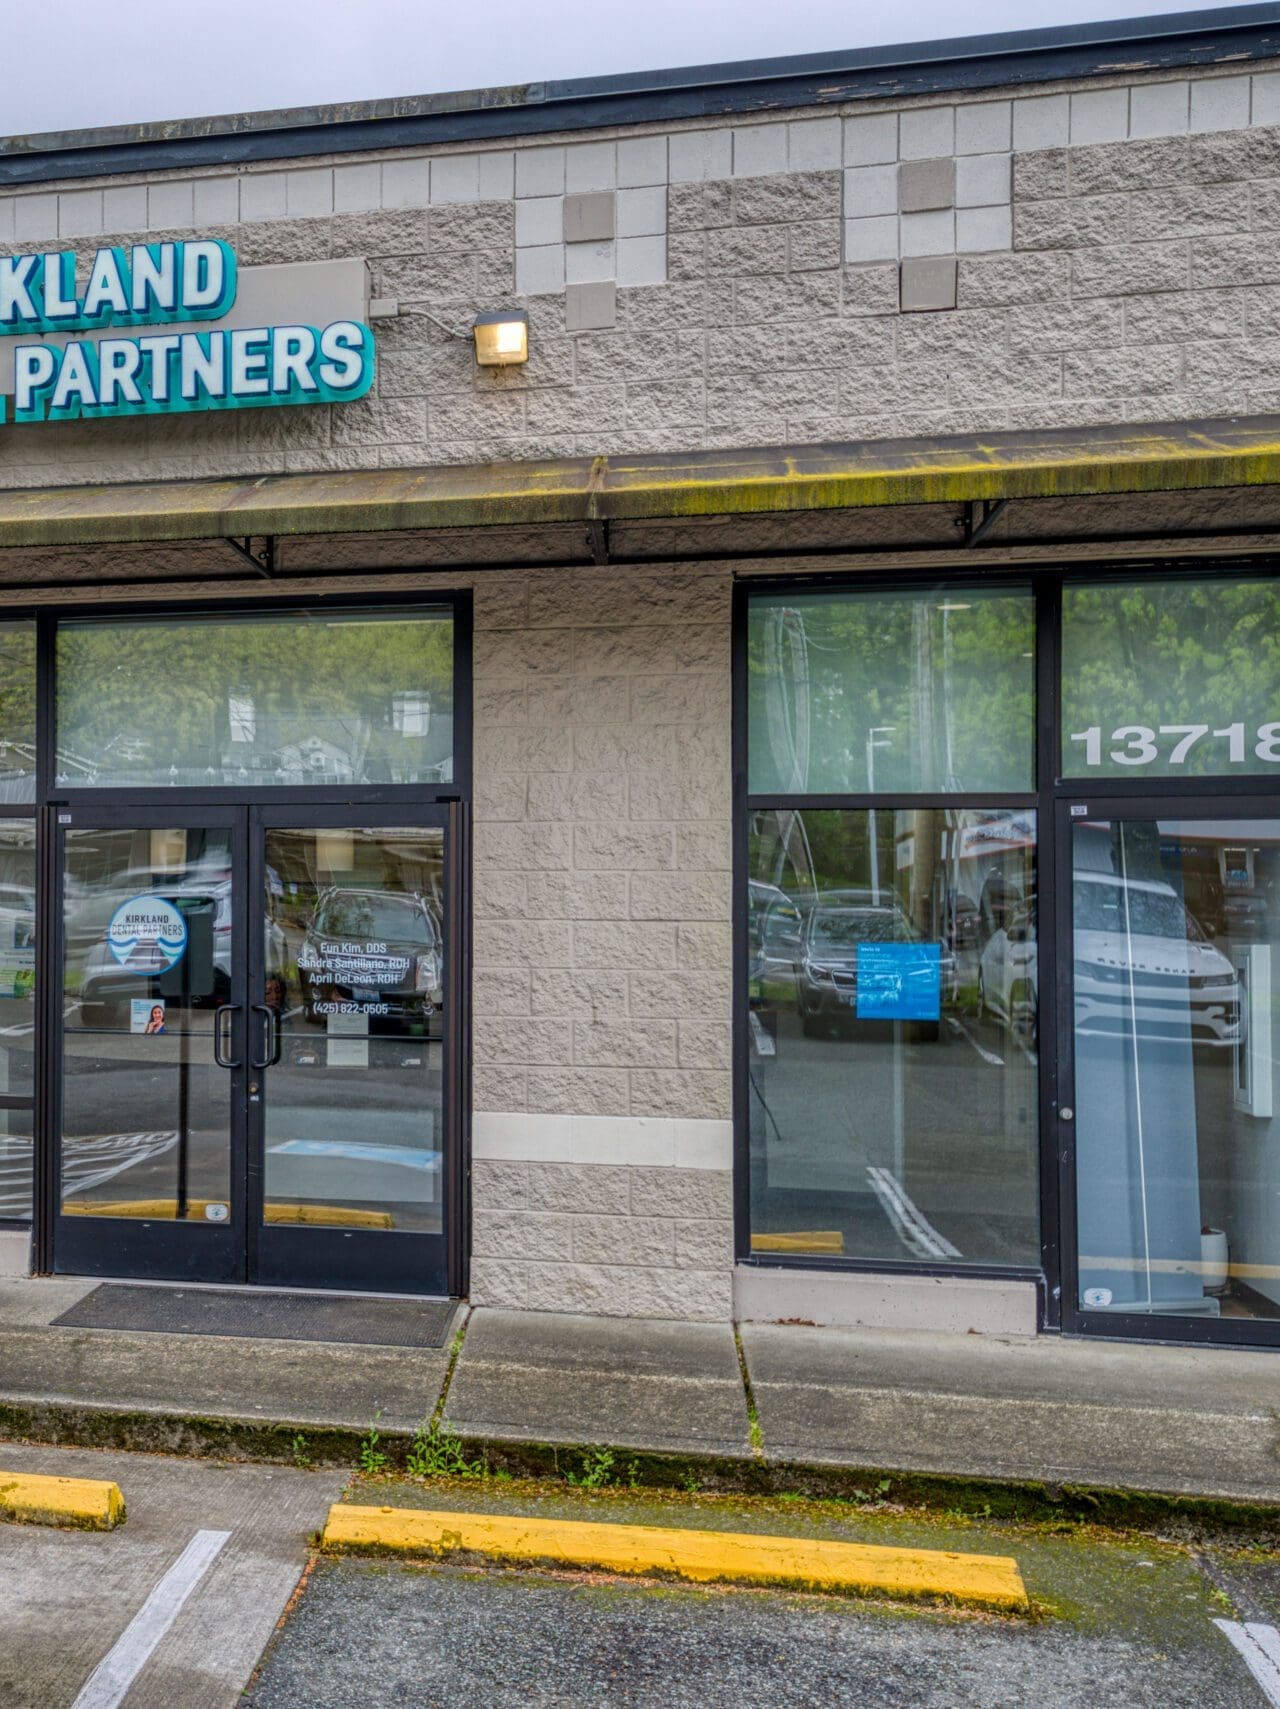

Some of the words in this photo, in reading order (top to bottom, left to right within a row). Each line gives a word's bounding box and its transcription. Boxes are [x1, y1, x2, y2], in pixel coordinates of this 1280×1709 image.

[14, 319, 369, 411] PARTNERS
[125, 914, 169, 924] KIRKLAND
[112, 924, 140, 936] DENTAL
[143, 924, 183, 936] PARTNERS
[320, 943, 339, 954] Eun
[342, 943, 364, 955] Kim,
[366, 943, 387, 954] DDS
[297, 958, 333, 969] Sandra
[389, 958, 410, 969] RDH
[309, 973, 332, 986] April
[335, 973, 375, 985] DeLeon,
[377, 973, 399, 984] RDH
[313, 1003, 339, 1016] (425)
[340, 1003, 389, 1015] 822-0505
